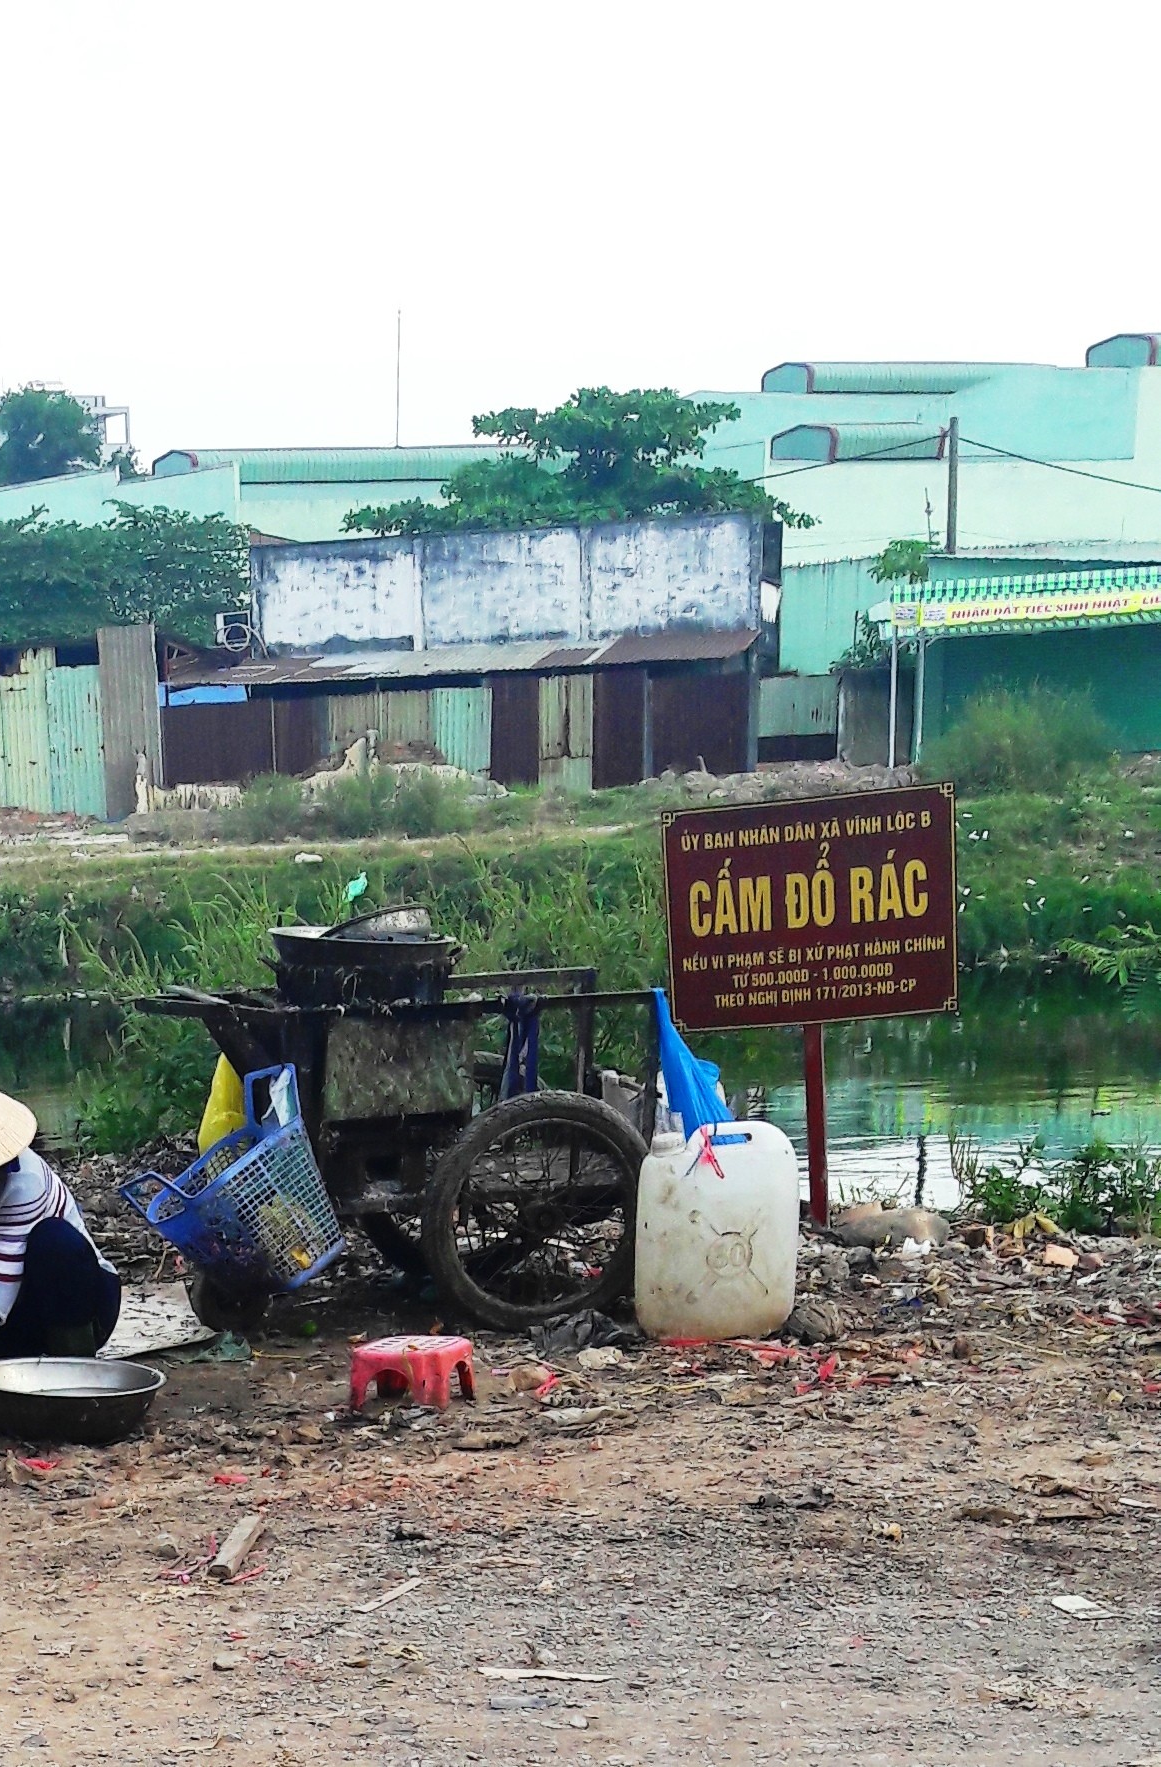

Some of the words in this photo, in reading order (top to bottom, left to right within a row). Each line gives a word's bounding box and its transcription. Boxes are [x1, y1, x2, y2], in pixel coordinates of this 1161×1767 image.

[1056, 601, 1089, 612] SINH
[704, 832, 734, 850] BAN
[738, 823, 780, 847] NHÂN
[784, 821, 815, 842] DÂN
[819, 816, 840, 840] XÃ
[845, 814, 882, 837] VĨNH
[886, 810, 916, 833] LỘC
[920, 810, 931, 827] B
[689, 857, 772, 937] CẤM
[785, 841, 836, 929] ĐỔ
[850, 848, 929, 924] RÁC
[683, 950, 708, 972] NẾU
[711, 954, 723, 969] VI
[727, 949, 764, 970] PHẠM
[768, 945, 785, 964] SẼ
[789, 947, 802, 965] BỊ
[827, 944, 860, 964] PHẠT
[864, 937, 901, 956] HÀNH
[905, 935, 946, 953] CHÍNH
[732, 968, 749, 989] TỪ
[752, 966, 809, 987] 500.000Đ
[823, 962, 893, 982] 1.000.000Đ
[714, 992, 745, 1009] THEO
[748, 989, 778, 1008] NGHỊ
[782, 988, 812, 1005] ĐỊNH
[816, 978, 917, 1000] 171/2013-NĐ-CP
